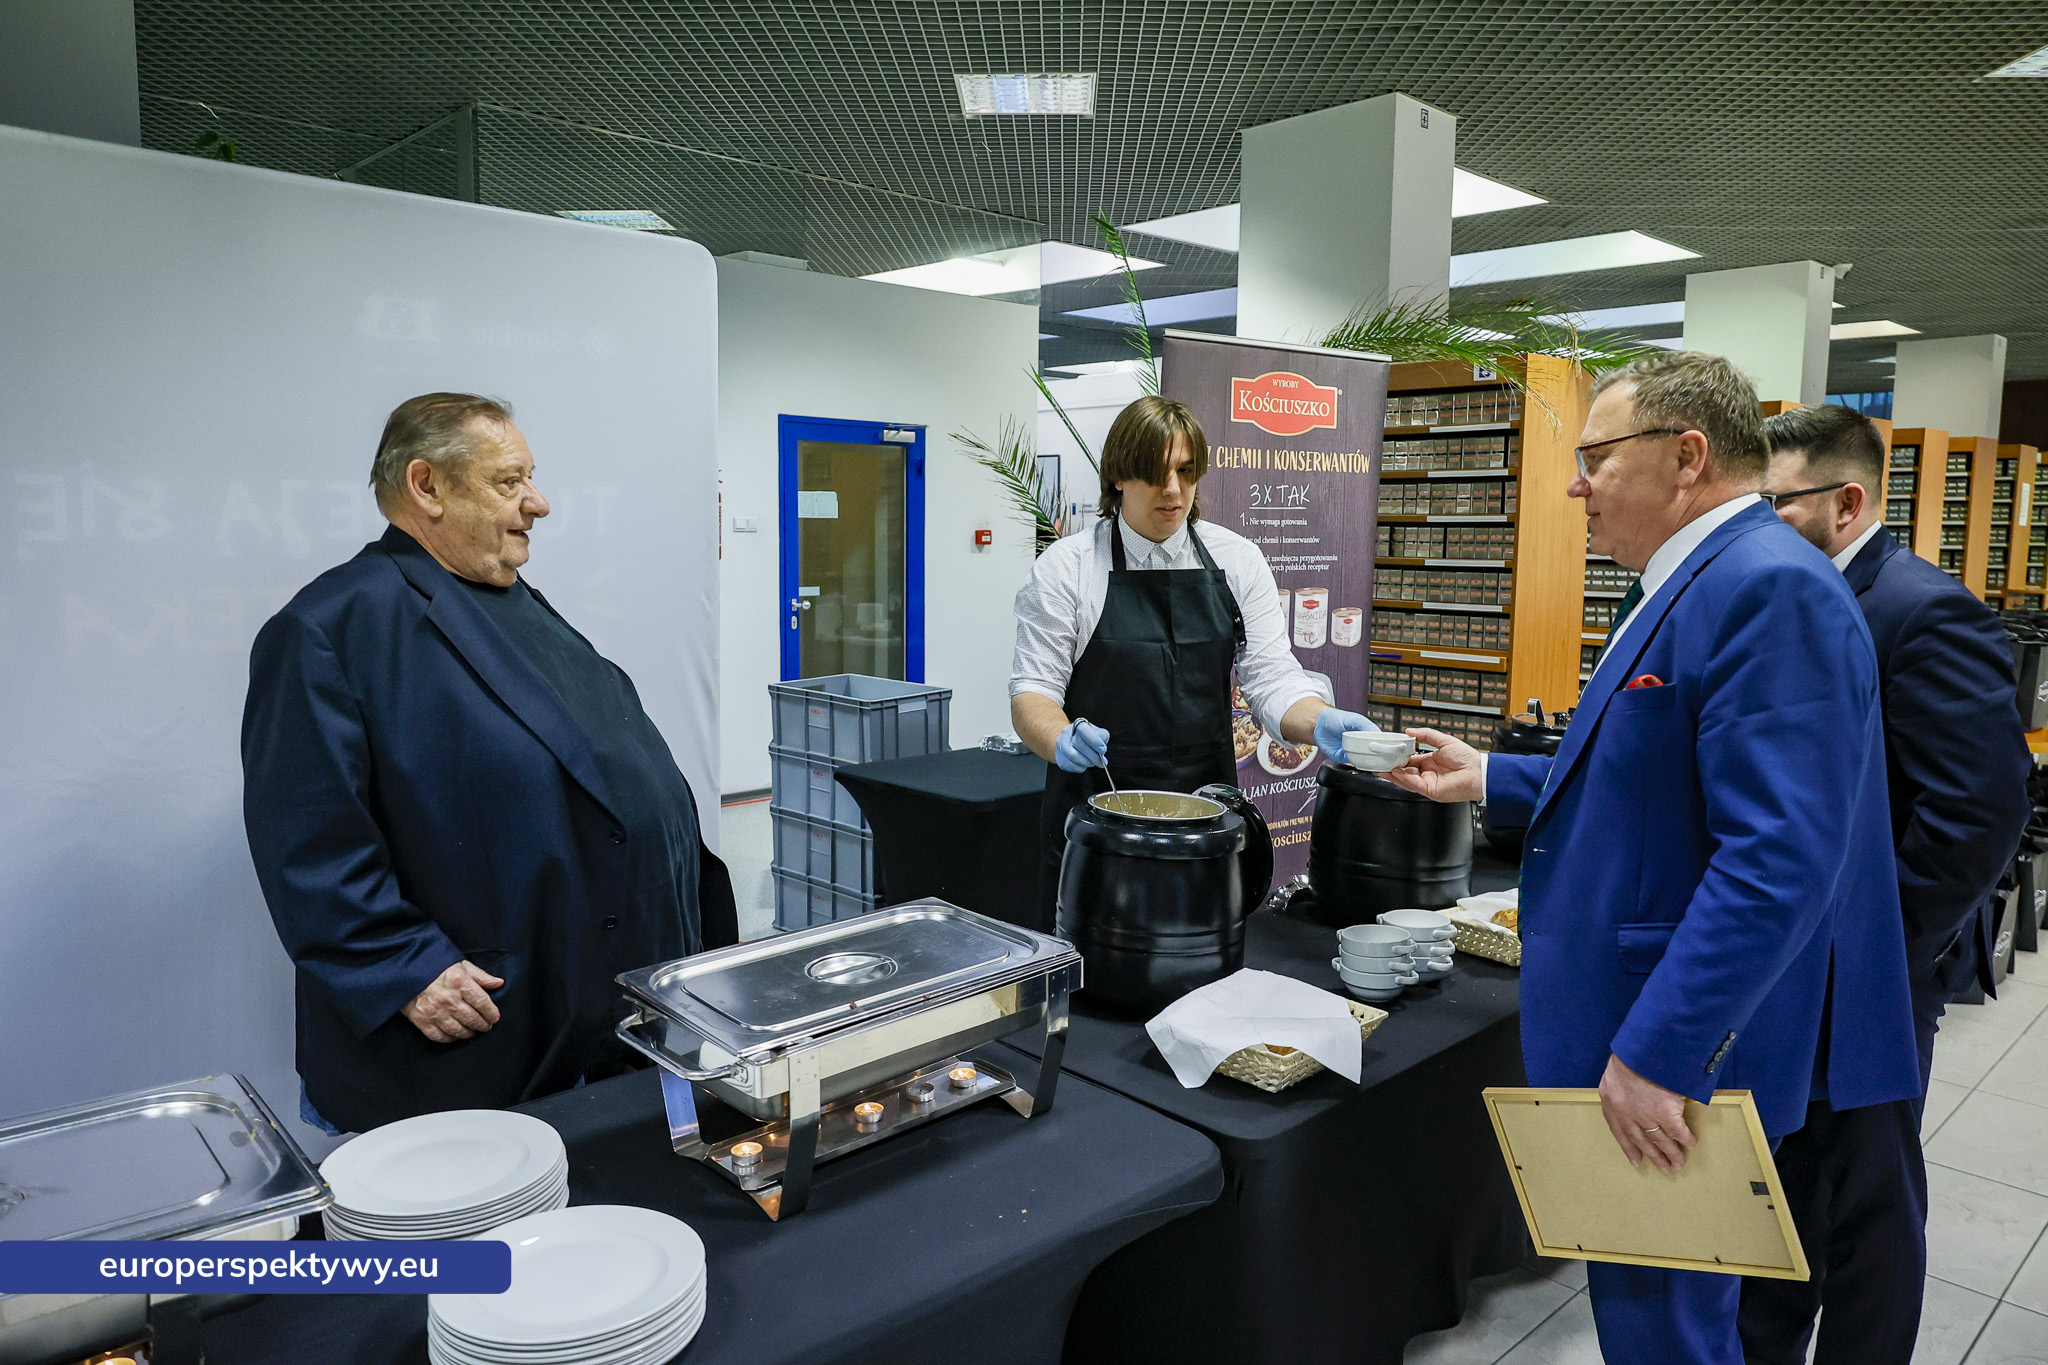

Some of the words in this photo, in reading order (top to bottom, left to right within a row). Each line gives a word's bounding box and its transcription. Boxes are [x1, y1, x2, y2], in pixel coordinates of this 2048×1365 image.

[1272, 379, 1299, 389] WYROBY
[1238, 389, 1330, 417] KOŚCIUSZKO
[1216, 445, 1261, 470] CHEMII
[1266, 449, 1271, 470] I
[1274, 449, 1371, 474] KONSERWANTÓW
[1276, 484, 1311, 507] TAK
[1239, 511, 1249, 527] 1.
[1250, 517, 1259, 525] Nie
[1254, 536, 1261, 544] od
[1262, 536, 1279, 544] chemii
[1250, 784, 1268, 800] JAN
